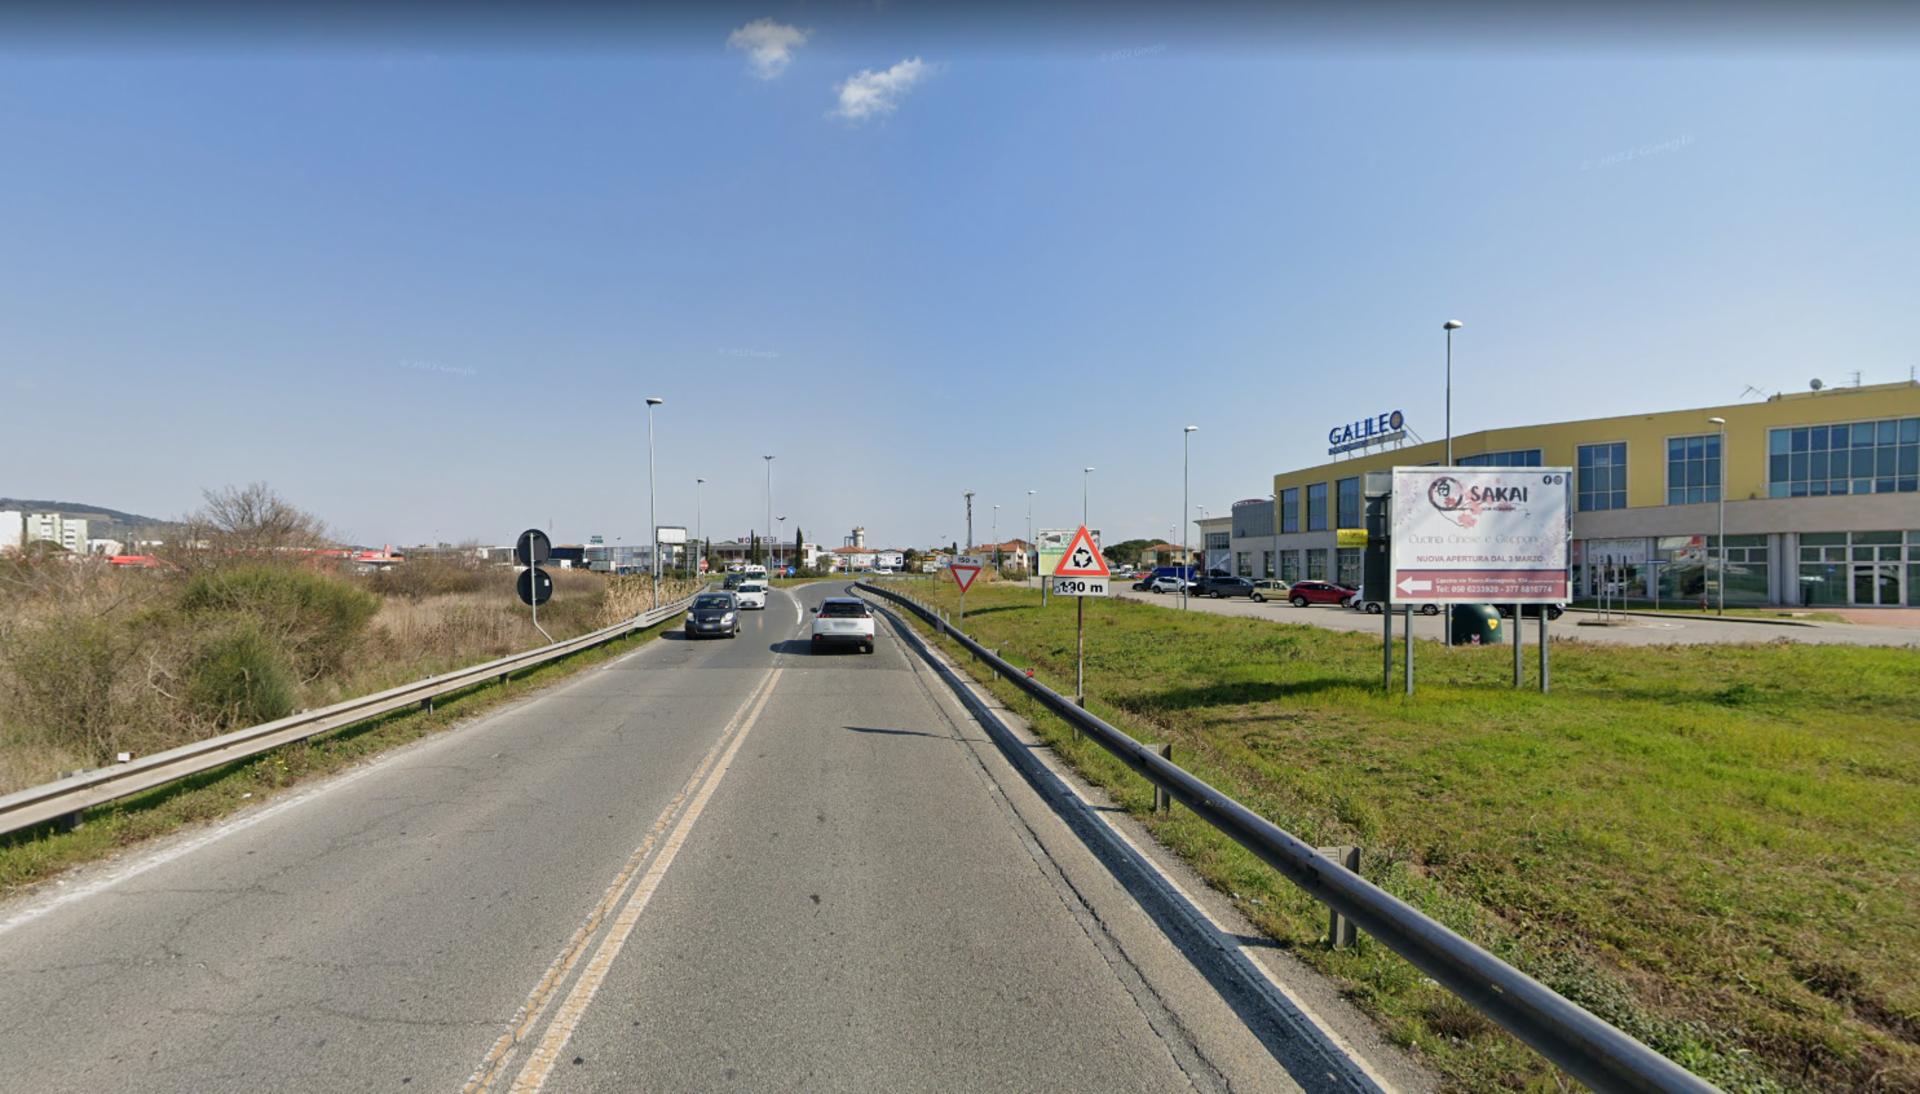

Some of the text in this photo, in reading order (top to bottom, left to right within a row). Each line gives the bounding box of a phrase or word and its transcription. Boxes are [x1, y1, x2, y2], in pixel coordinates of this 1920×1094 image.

[1329, 410, 1404, 445] GALILEO
[1471, 486, 1528, 503] SAKAI
[1408, 534, 1444, 545] Cucina
[1090, 584, 1103, 592] m
